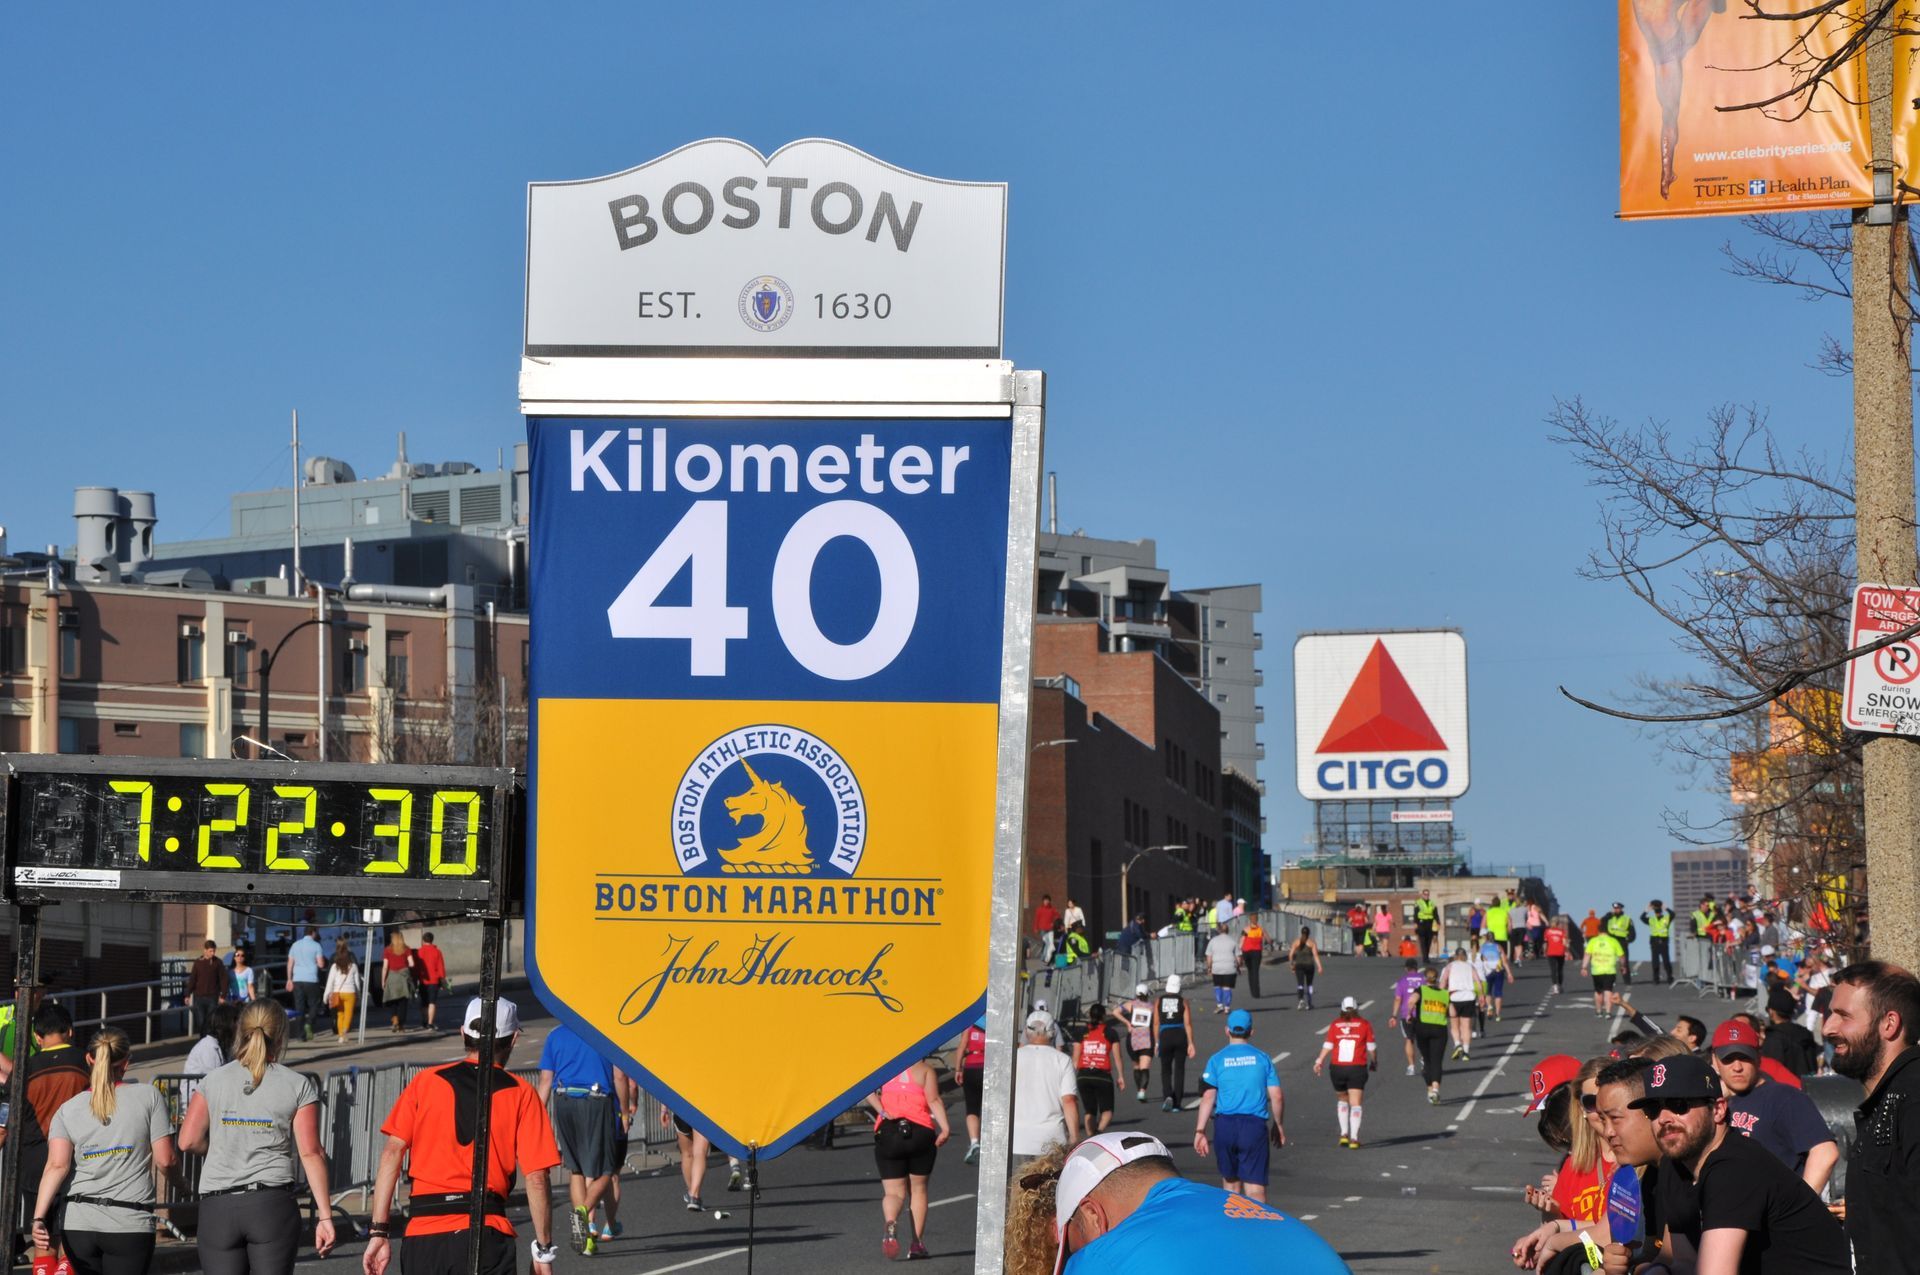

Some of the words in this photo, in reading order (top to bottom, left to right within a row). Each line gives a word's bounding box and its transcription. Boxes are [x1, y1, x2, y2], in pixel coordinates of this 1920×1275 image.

[1693, 141, 1852, 162] www.celebrityseries.org
[1694, 183, 1745, 198] TUFTS
[1769, 177, 1816, 193] Health
[1820, 176, 1850, 190] Plan
[608, 175, 923, 253] BOSTON
[638, 291, 702, 319] EST.
[814, 292, 892, 320] 1630
[569, 427, 970, 495] Kilometer
[606, 500, 920, 681] 40
[1862, 592, 1895, 609] TOW
[1866, 692, 1920, 711] SNOW
[1881, 684, 1911, 695] during
[1317, 758, 1449, 792] CITGO
[678, 779, 705, 862] BOSTON
[697, 730, 791, 780] ATHLETIC
[793, 737, 861, 863] ASSOCIATION
[595, 882, 728, 913] BOSTON
[618, 933, 730, 1026] John
[1532, 1071, 1546, 1095] B
[1651, 1064, 1667, 1088] B
[1731, 1111, 1760, 1132] SOX
[1224, 1206, 1285, 1221] adidas
